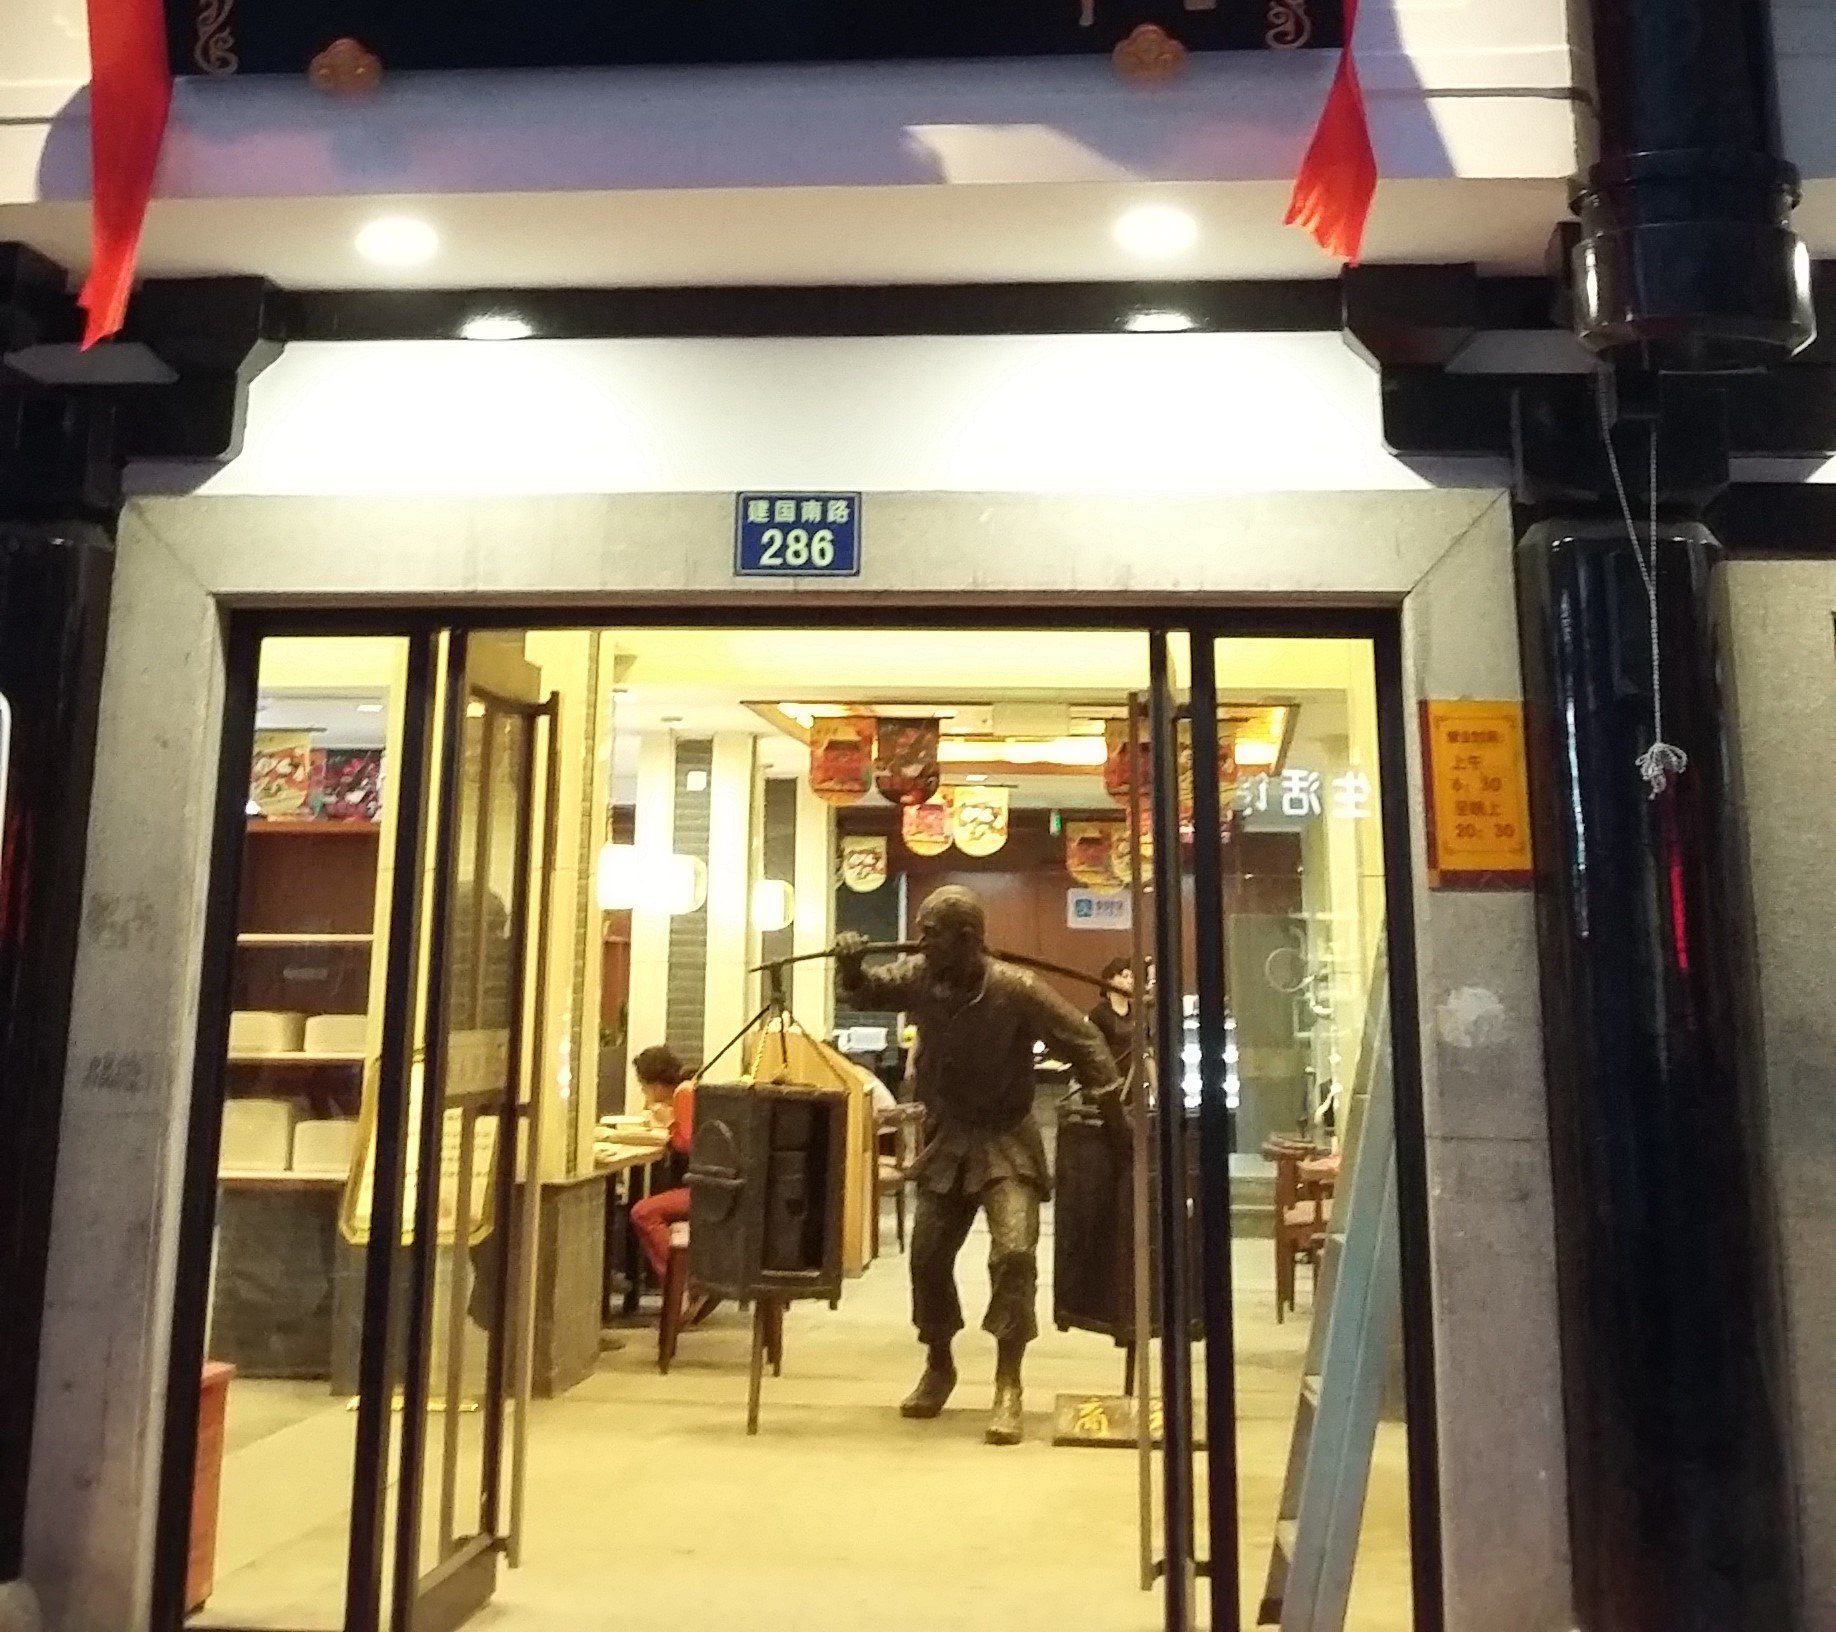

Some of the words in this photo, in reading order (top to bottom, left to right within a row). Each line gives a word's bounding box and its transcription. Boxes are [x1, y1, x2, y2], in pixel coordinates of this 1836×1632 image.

[747, 499, 850, 523] 建国南路
[760, 528, 834, 567] 286
